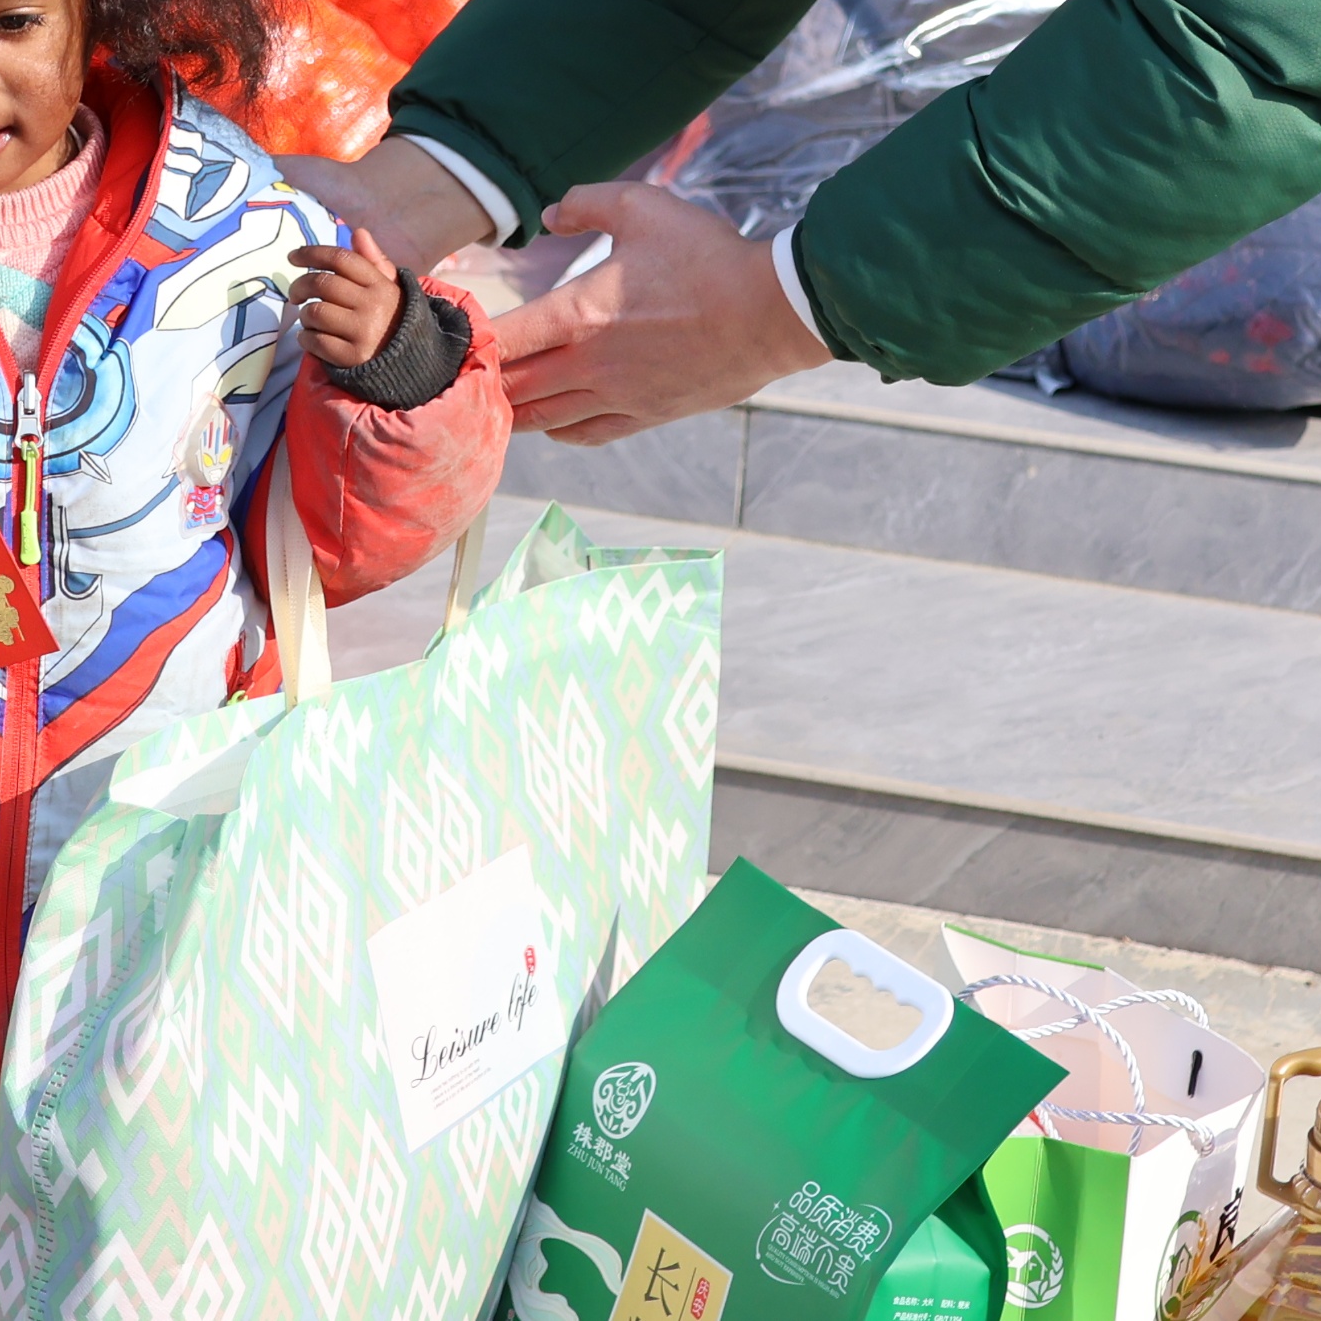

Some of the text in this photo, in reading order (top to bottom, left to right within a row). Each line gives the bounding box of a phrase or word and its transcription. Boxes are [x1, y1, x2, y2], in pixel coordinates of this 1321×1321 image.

[411, 1011, 502, 1089] Leisure
[507, 968, 538, 1032] life
[565, 1143, 630, 1192] ZHU JUN TANG
[771, 1211, 857, 1294] 高端不贵
[789, 1181, 881, 1257] 品质消费
[631, 1247, 681, 1321] 长
[692, 1279, 709, 1316] 庆安
